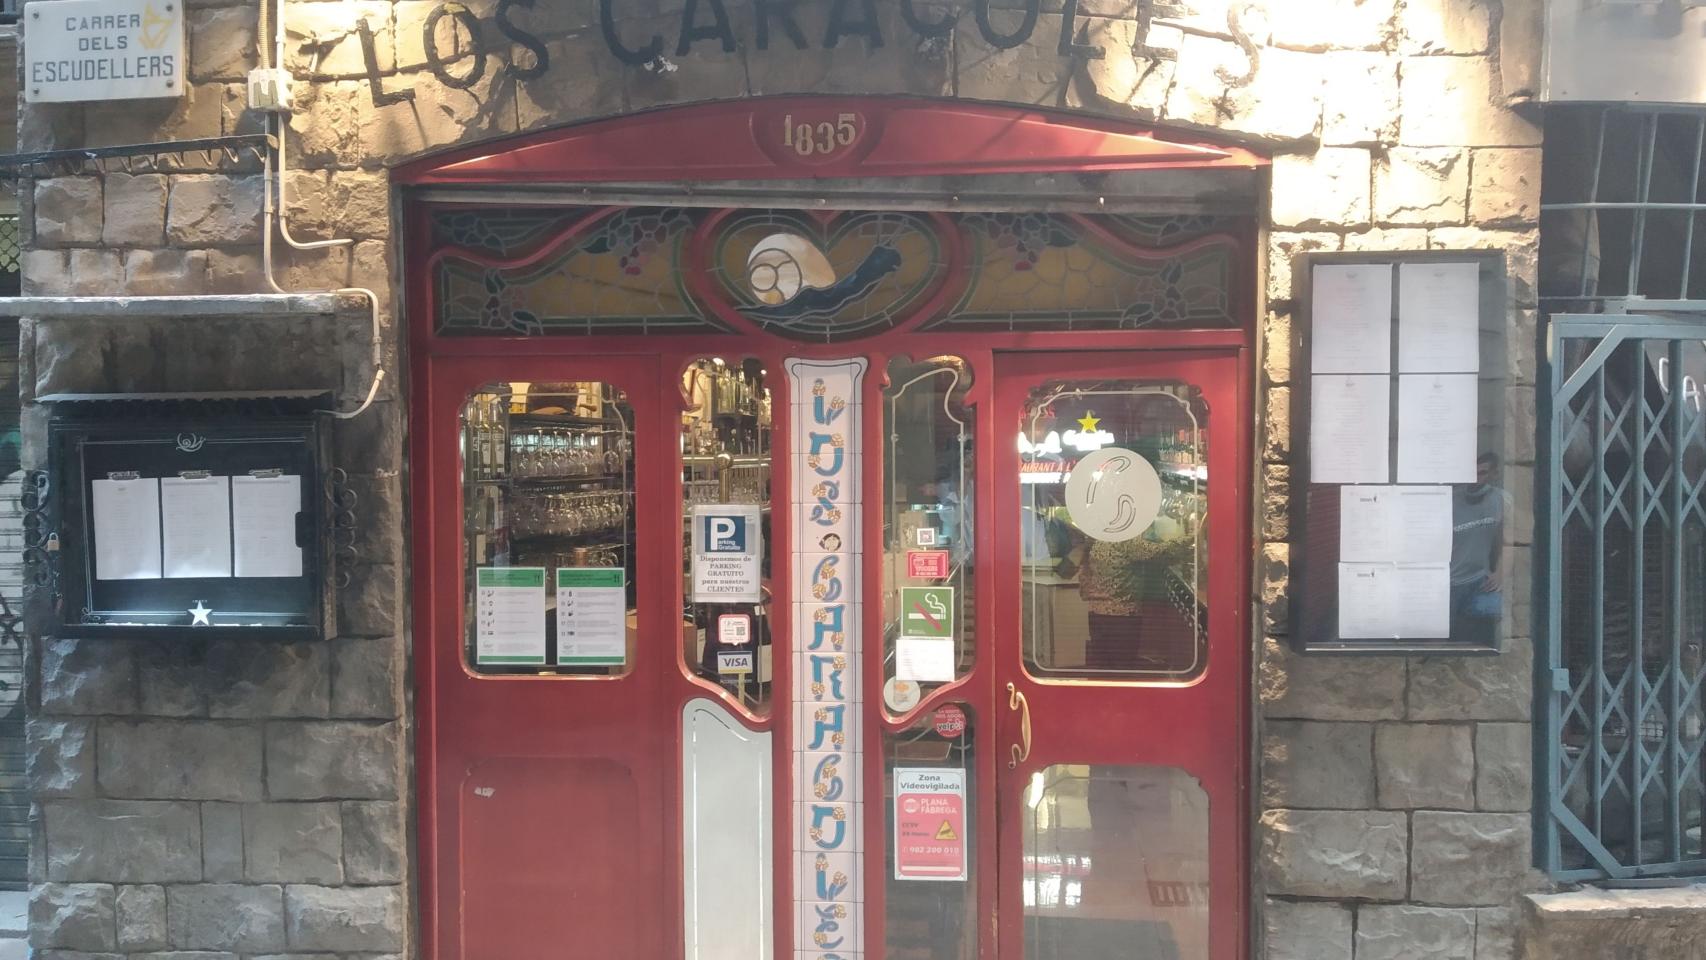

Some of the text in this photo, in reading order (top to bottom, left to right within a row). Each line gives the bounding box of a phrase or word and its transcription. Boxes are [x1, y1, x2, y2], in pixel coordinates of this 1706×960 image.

[66, 14, 141, 31] CARRER
[79, 36, 128, 51] DELS
[356, 0, 549, 107] LOS
[32, 55, 174, 83] ESCUDELLERS
[784, 113, 856, 155] 1835
[1020, 462, 1056, 472] AURANT
[723, 657, 748, 667] VISA
[900, 782, 960, 791] Videovigilada
[920, 798, 948, 806] PLANA
